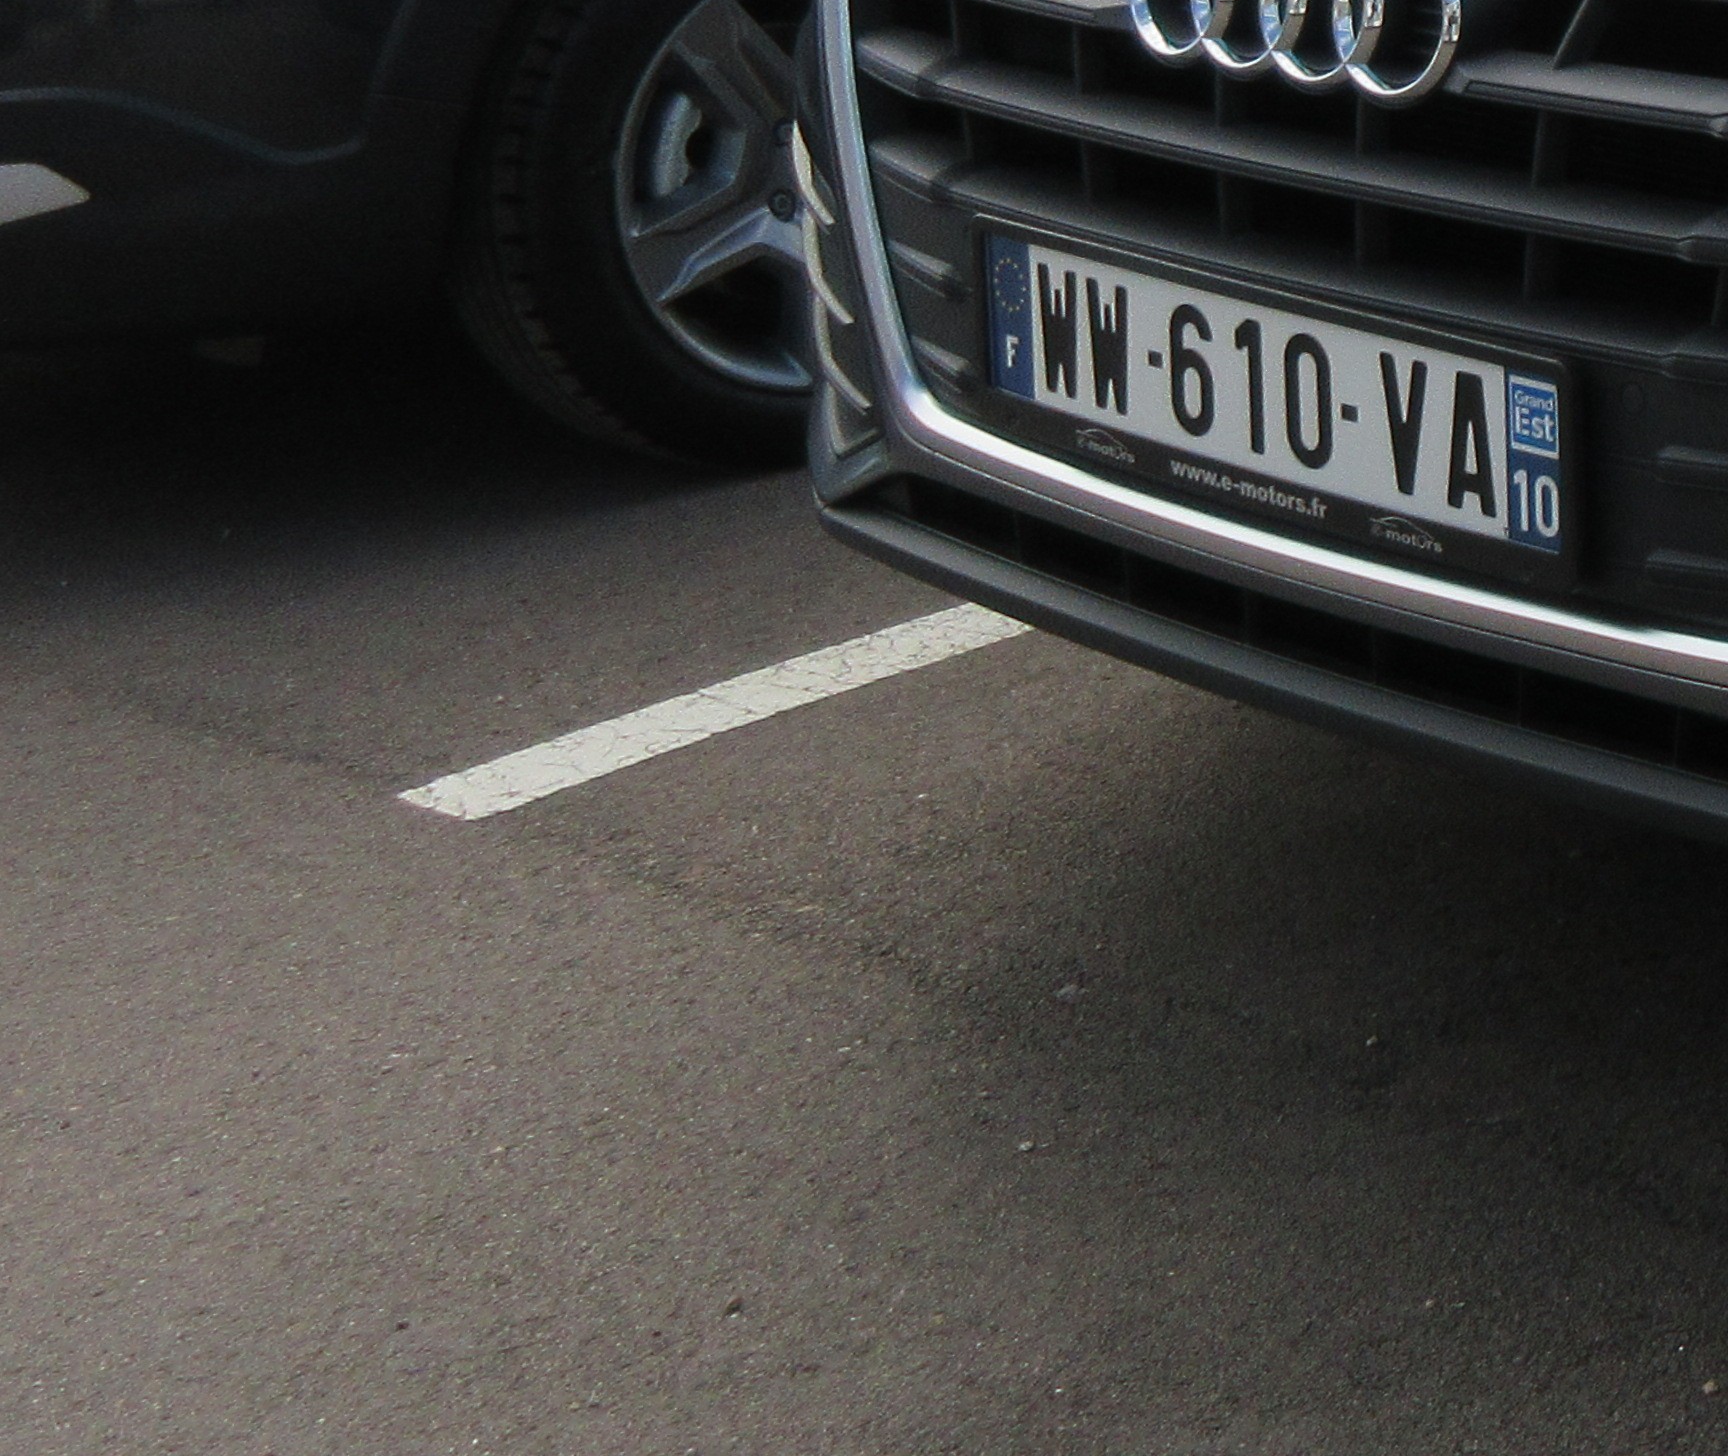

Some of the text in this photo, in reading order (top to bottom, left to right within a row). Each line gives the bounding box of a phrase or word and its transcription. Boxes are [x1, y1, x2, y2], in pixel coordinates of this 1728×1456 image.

[1004, 336, 1018, 369] F
[1037, 261, 1498, 519] WW-610-VA
[1514, 389, 1555, 412] Grand
[1514, 405, 1555, 443] Est
[1169, 456, 1328, 520] www.e-motors.fr
[1513, 468, 1560, 538] 10
